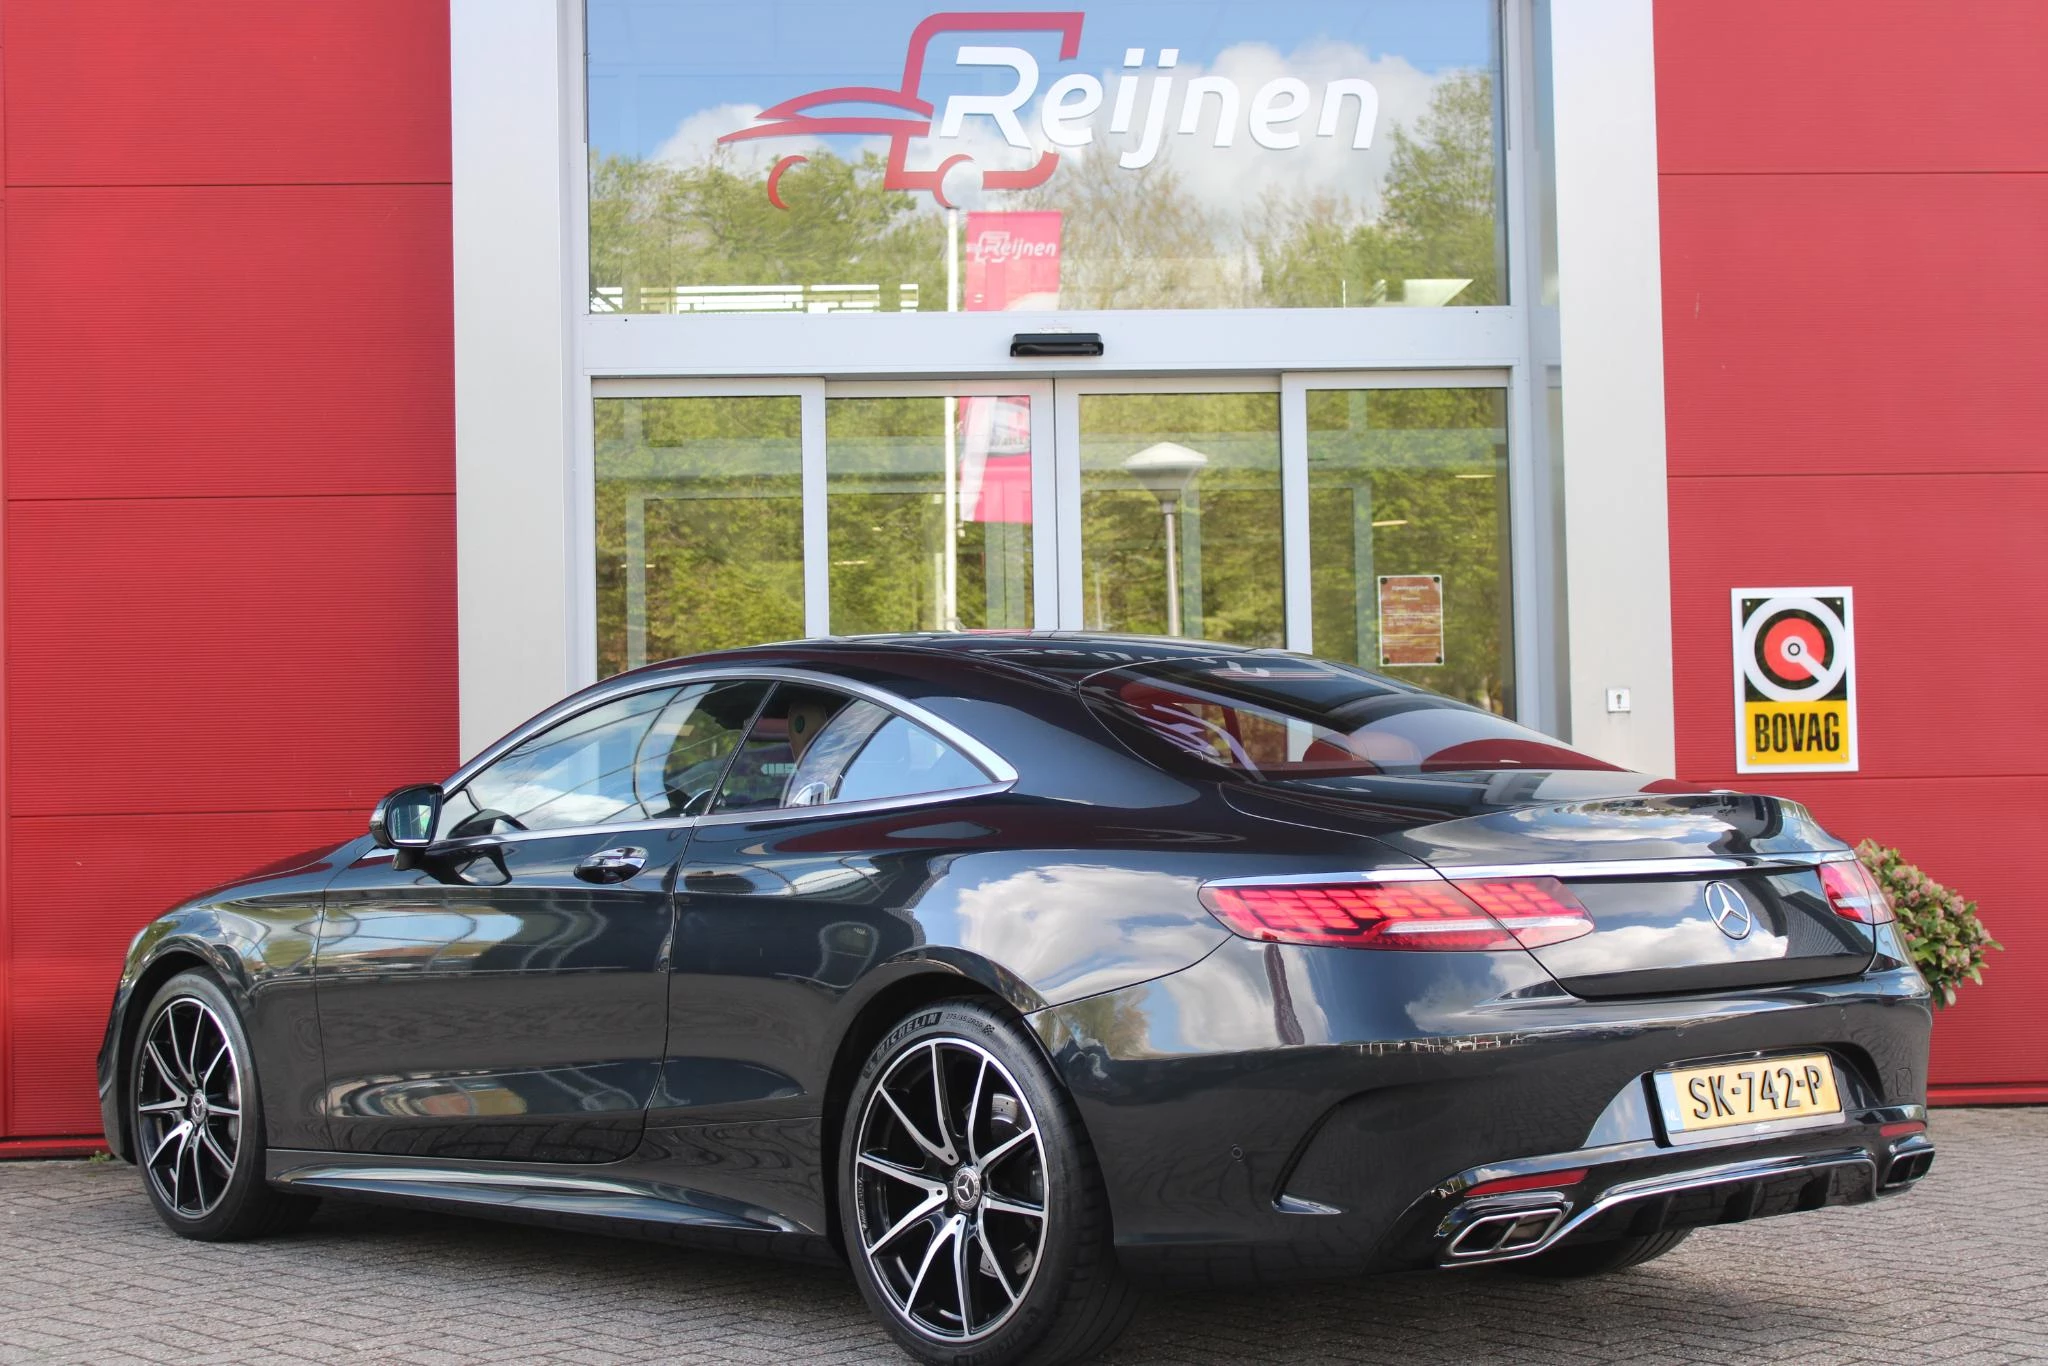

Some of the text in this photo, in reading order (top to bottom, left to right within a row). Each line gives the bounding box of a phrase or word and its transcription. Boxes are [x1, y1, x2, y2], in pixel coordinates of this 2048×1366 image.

[939, 46, 1380, 169] Reijnen
[985, 236, 1057, 260] Reijnen
[1754, 712, 1840, 753] BOVAG
[876, 1012, 939, 1061] MICHELIN
[1689, 1065, 1823, 1119] SK-742-P
